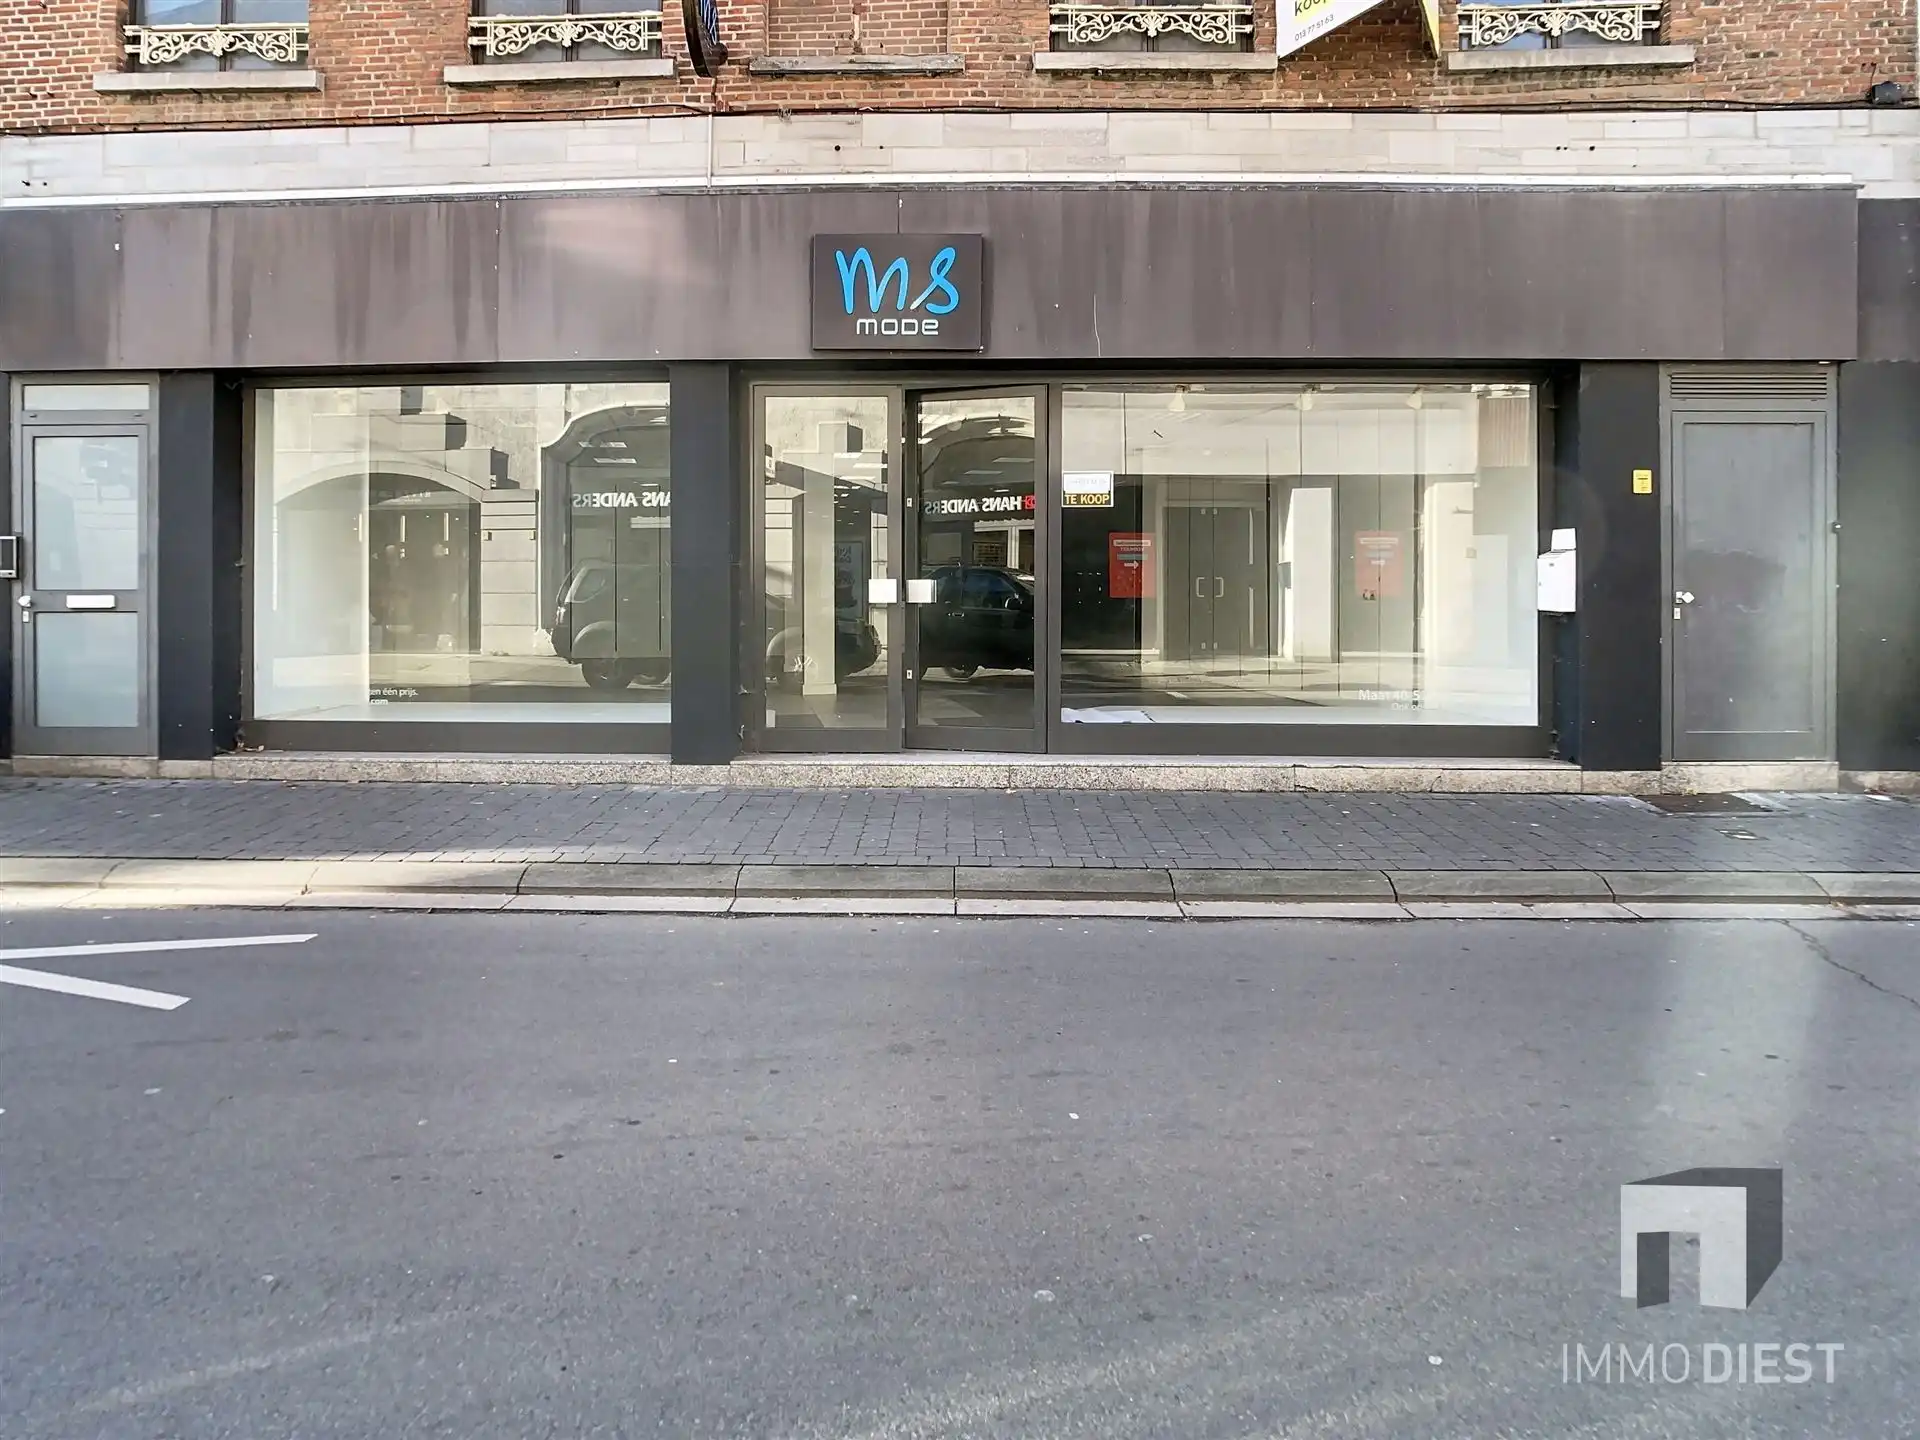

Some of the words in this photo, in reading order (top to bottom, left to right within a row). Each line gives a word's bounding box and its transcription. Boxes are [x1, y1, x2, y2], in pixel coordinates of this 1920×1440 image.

[1294, 0, 1327, 17] ko
[1064, 494, 1078, 505] TE
[1080, 494, 1110, 505] KOOP
